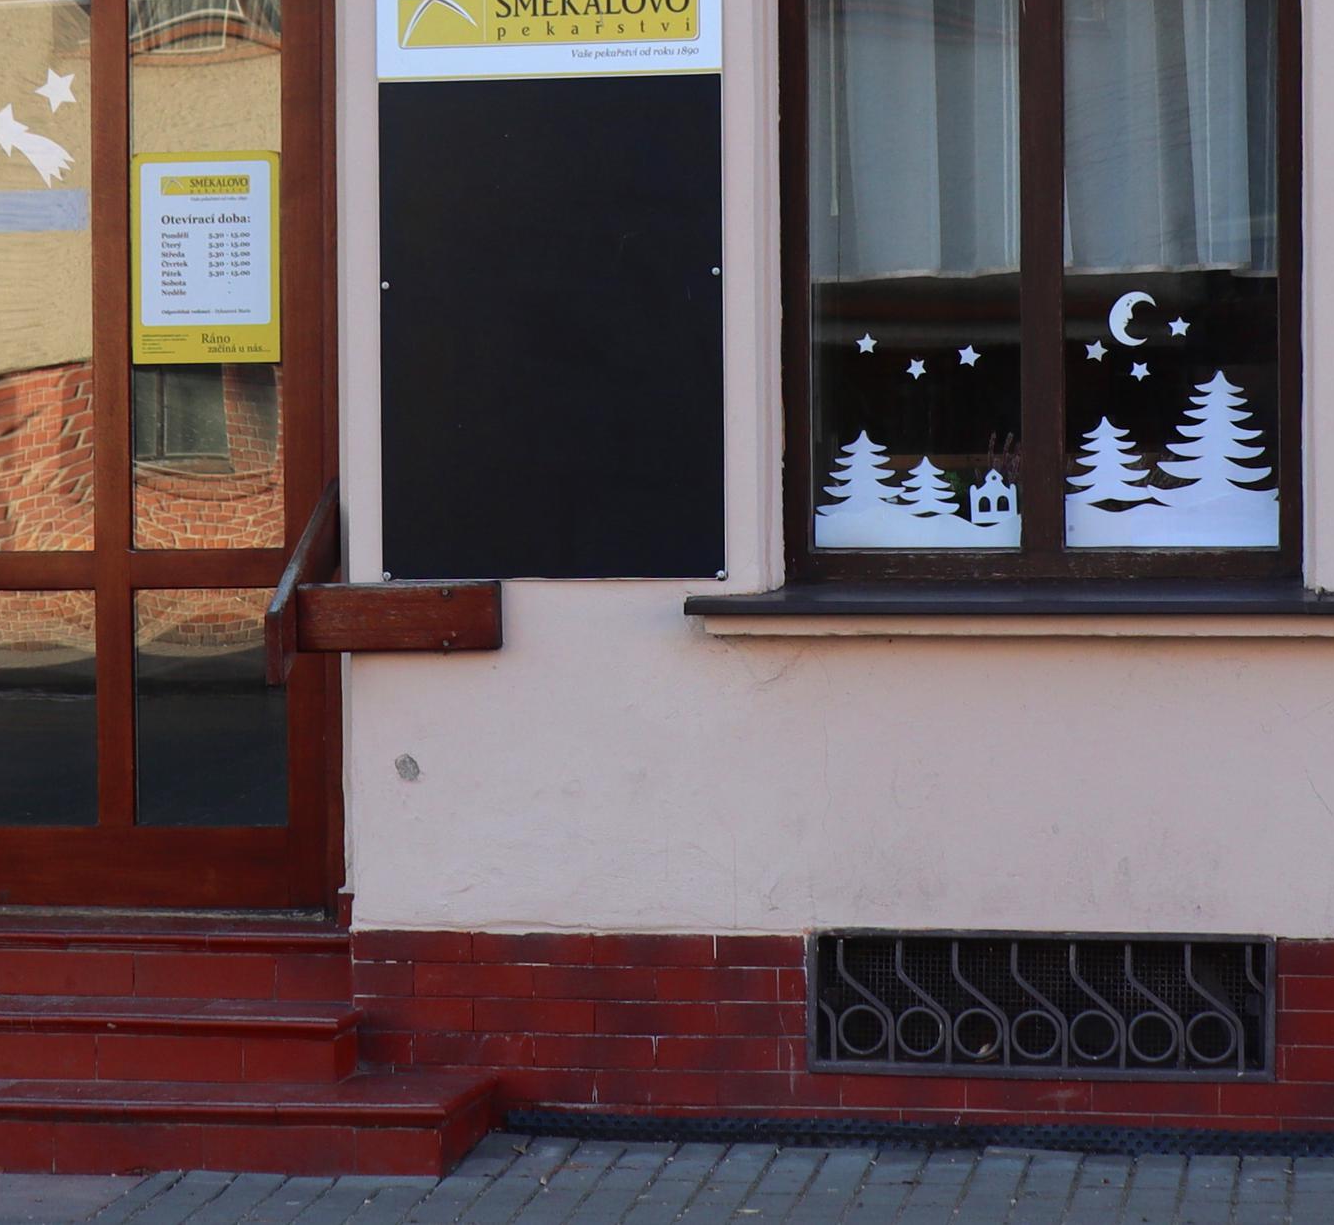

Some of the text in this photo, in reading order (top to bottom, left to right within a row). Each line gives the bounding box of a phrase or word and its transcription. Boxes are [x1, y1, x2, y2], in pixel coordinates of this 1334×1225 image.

[497, 18, 690, 40] pekařství
[571, 47, 699, 60] Vaše pekařství od roku 1890
[161, 213, 250, 225] Otevírací doba:
[202, 333, 230, 344] Ráno
[208, 344, 237, 353] začíná
